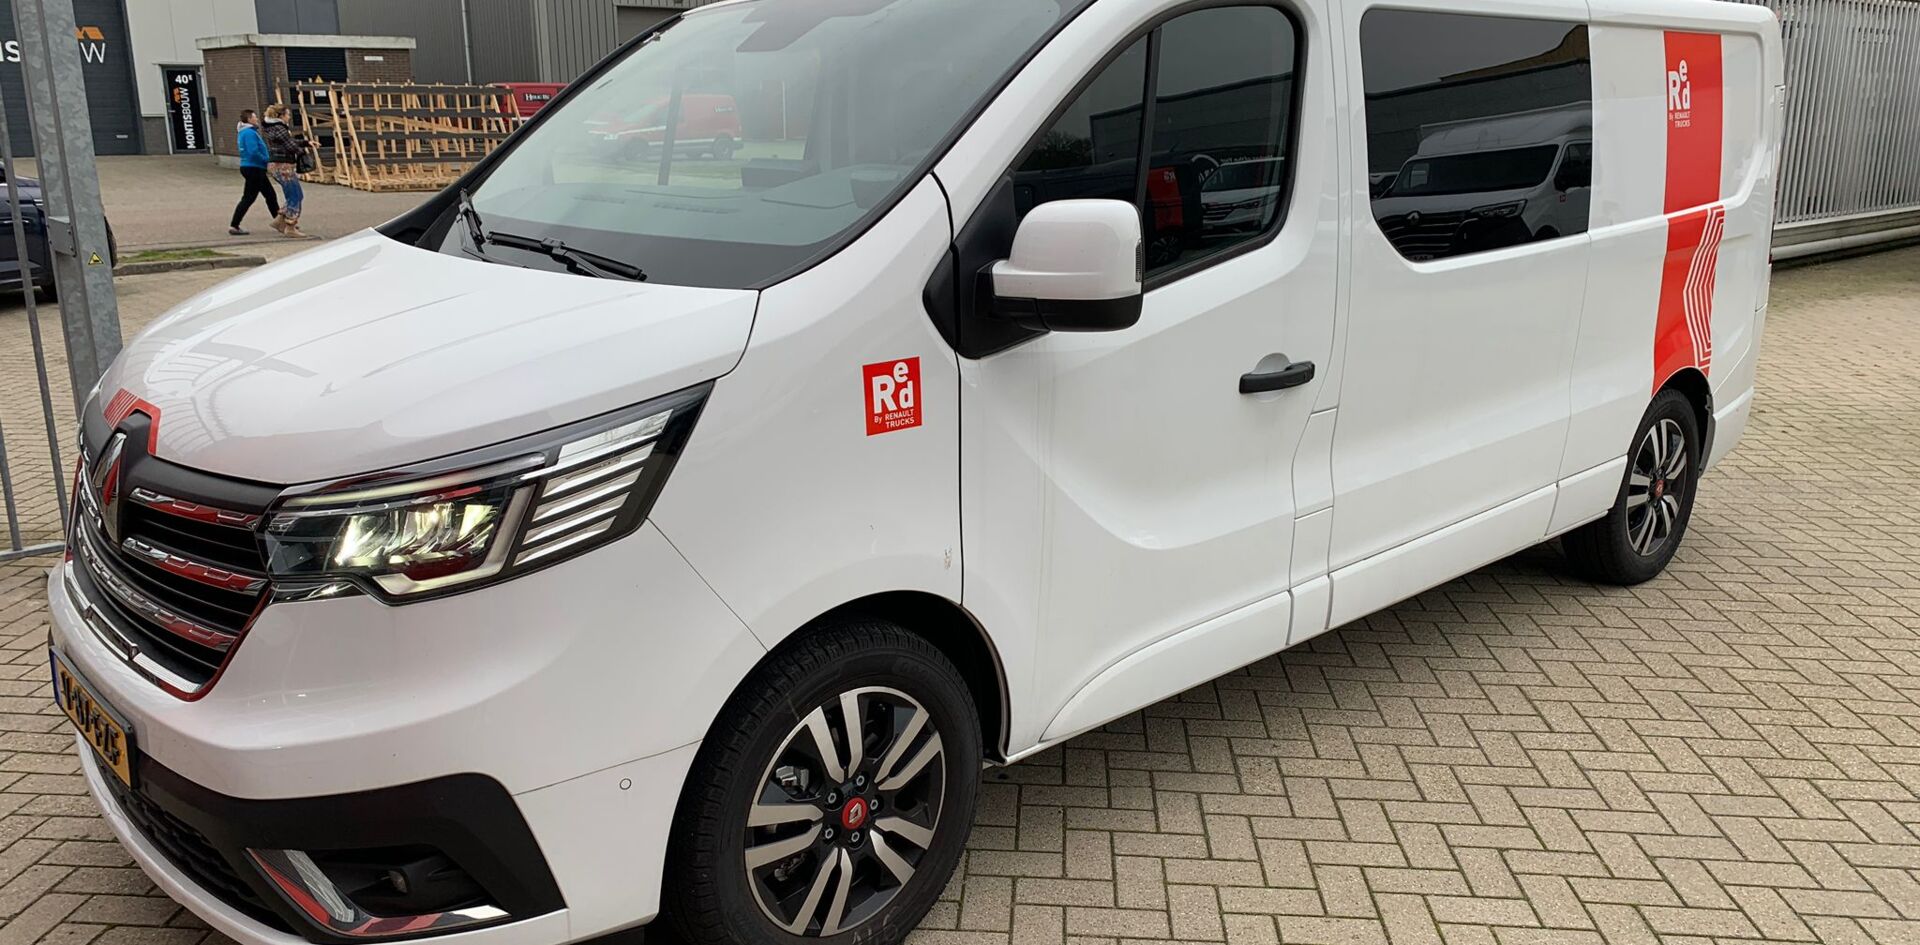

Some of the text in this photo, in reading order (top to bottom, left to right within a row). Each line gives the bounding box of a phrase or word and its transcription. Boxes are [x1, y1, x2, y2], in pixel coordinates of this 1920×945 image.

[179, 87, 196, 149] MONTISBOUW
[874, 408, 915, 424] By RENAULT
[885, 416, 915, 429] TRUCKS
